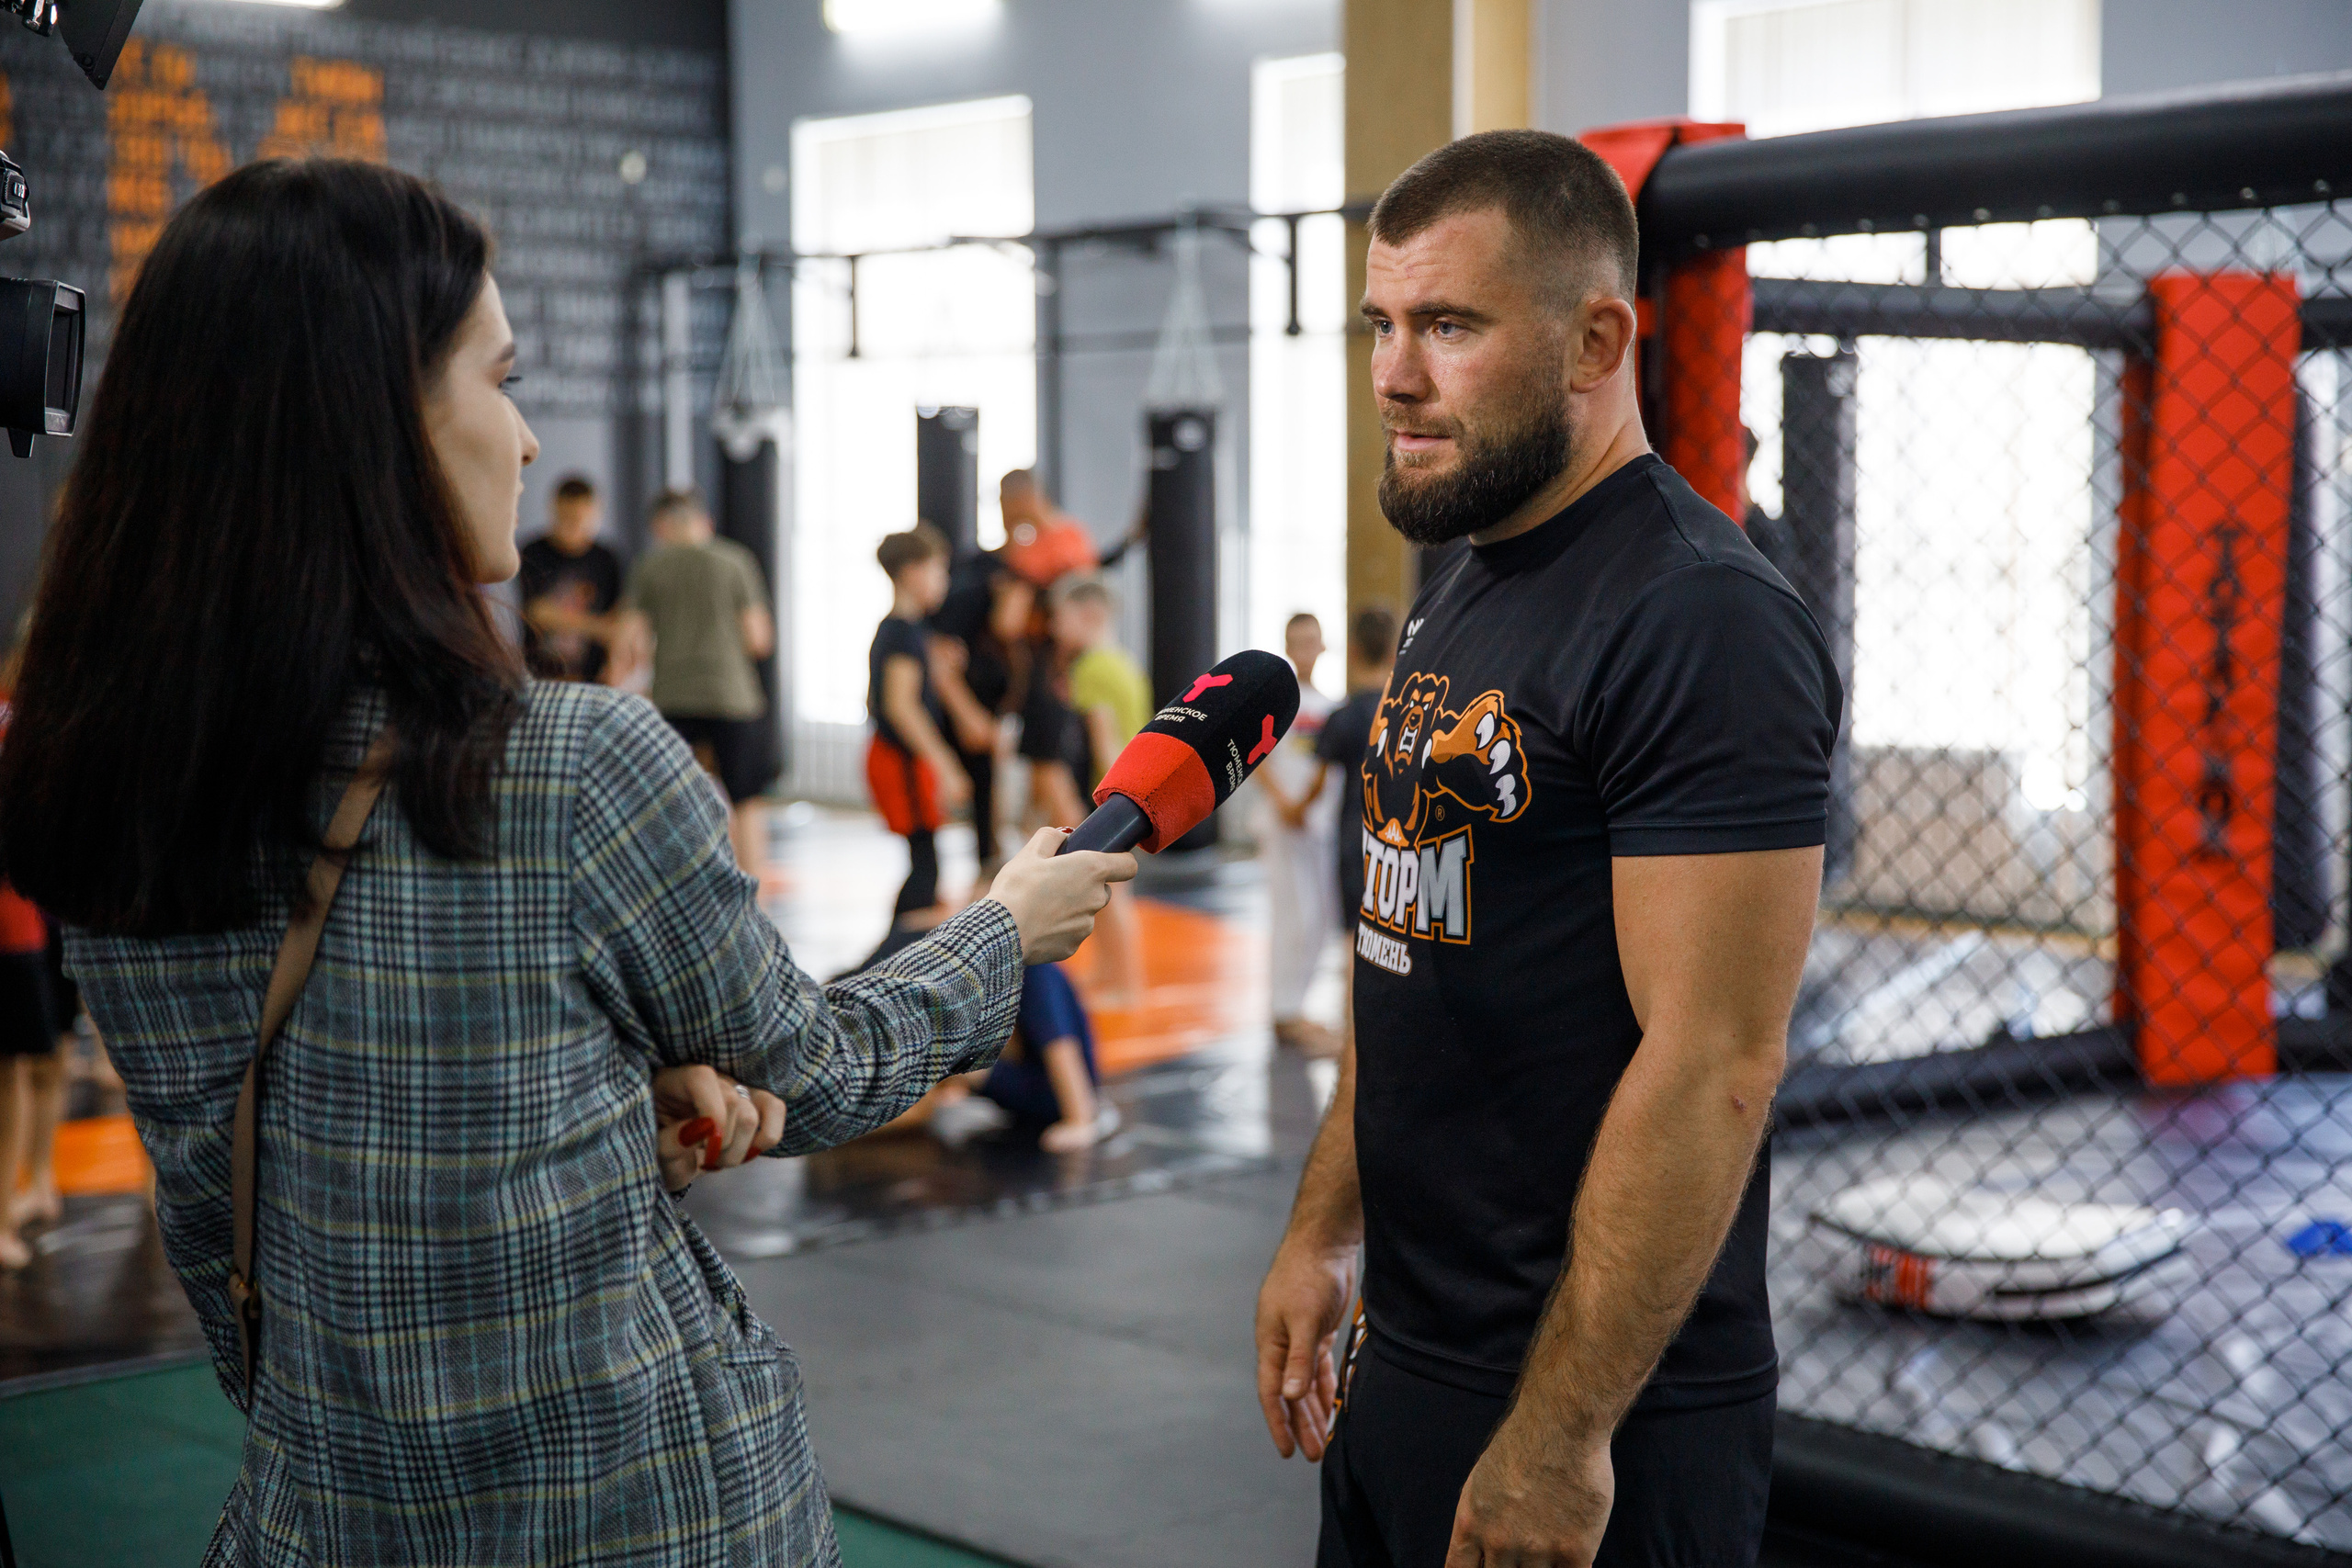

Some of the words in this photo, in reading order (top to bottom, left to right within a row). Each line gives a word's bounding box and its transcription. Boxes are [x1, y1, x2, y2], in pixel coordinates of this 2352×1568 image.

[1156, 706, 1208, 722] МЕНСКОЕ
[1227, 739, 1244, 788] ТЮМЕНС
[1362, 824, 1467, 937] ТОРМ
[1356, 921, 1411, 975] ТЮМЕНЬ
